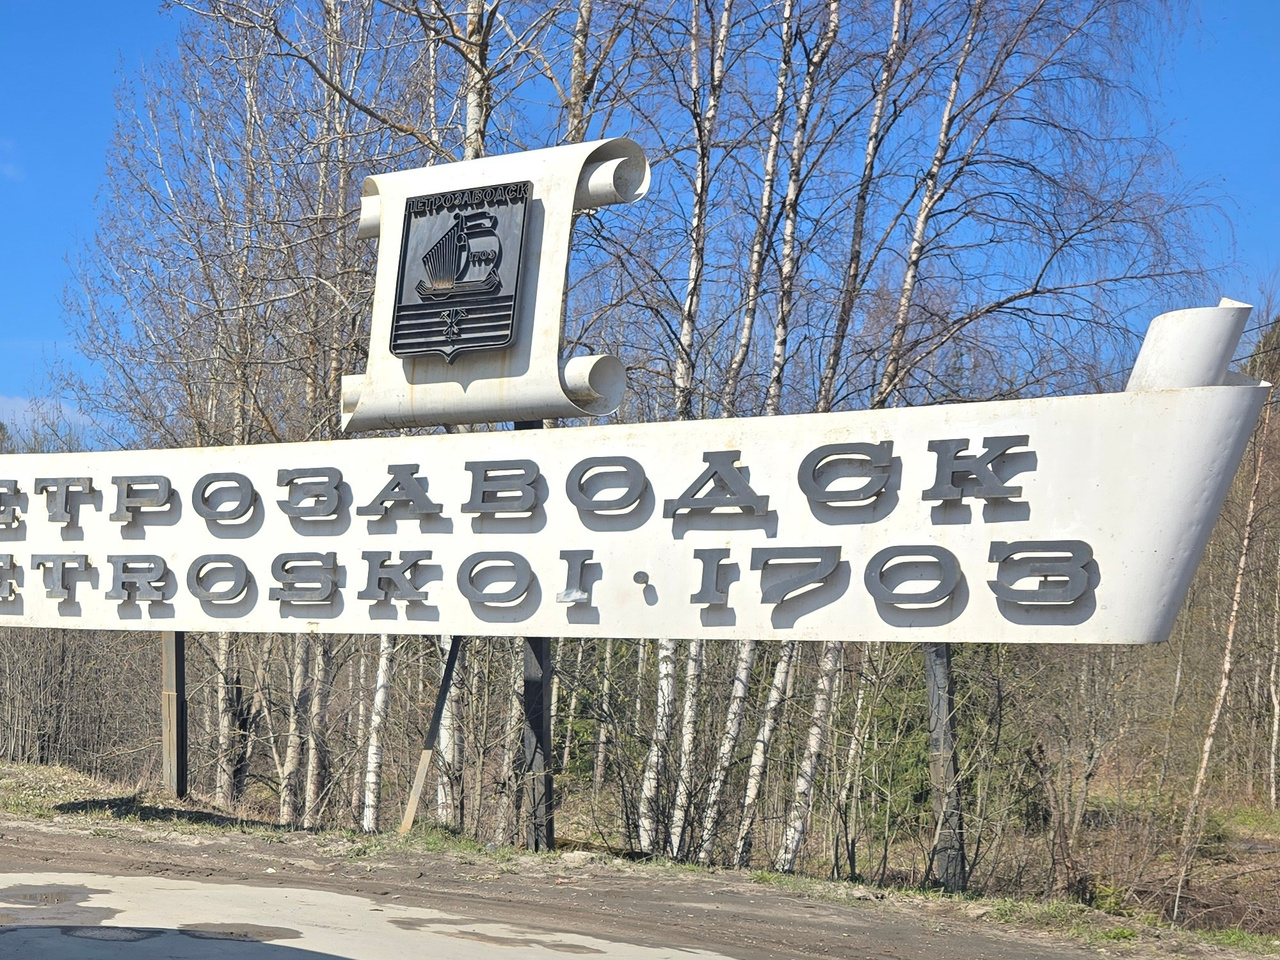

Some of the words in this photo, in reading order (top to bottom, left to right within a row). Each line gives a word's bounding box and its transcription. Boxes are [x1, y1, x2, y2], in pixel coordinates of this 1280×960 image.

[405, 182, 529, 214] ПЕТРОЗАВОДСК
[468, 248, 496, 261] 1703
[690, 539, 1093, 606] 1703
